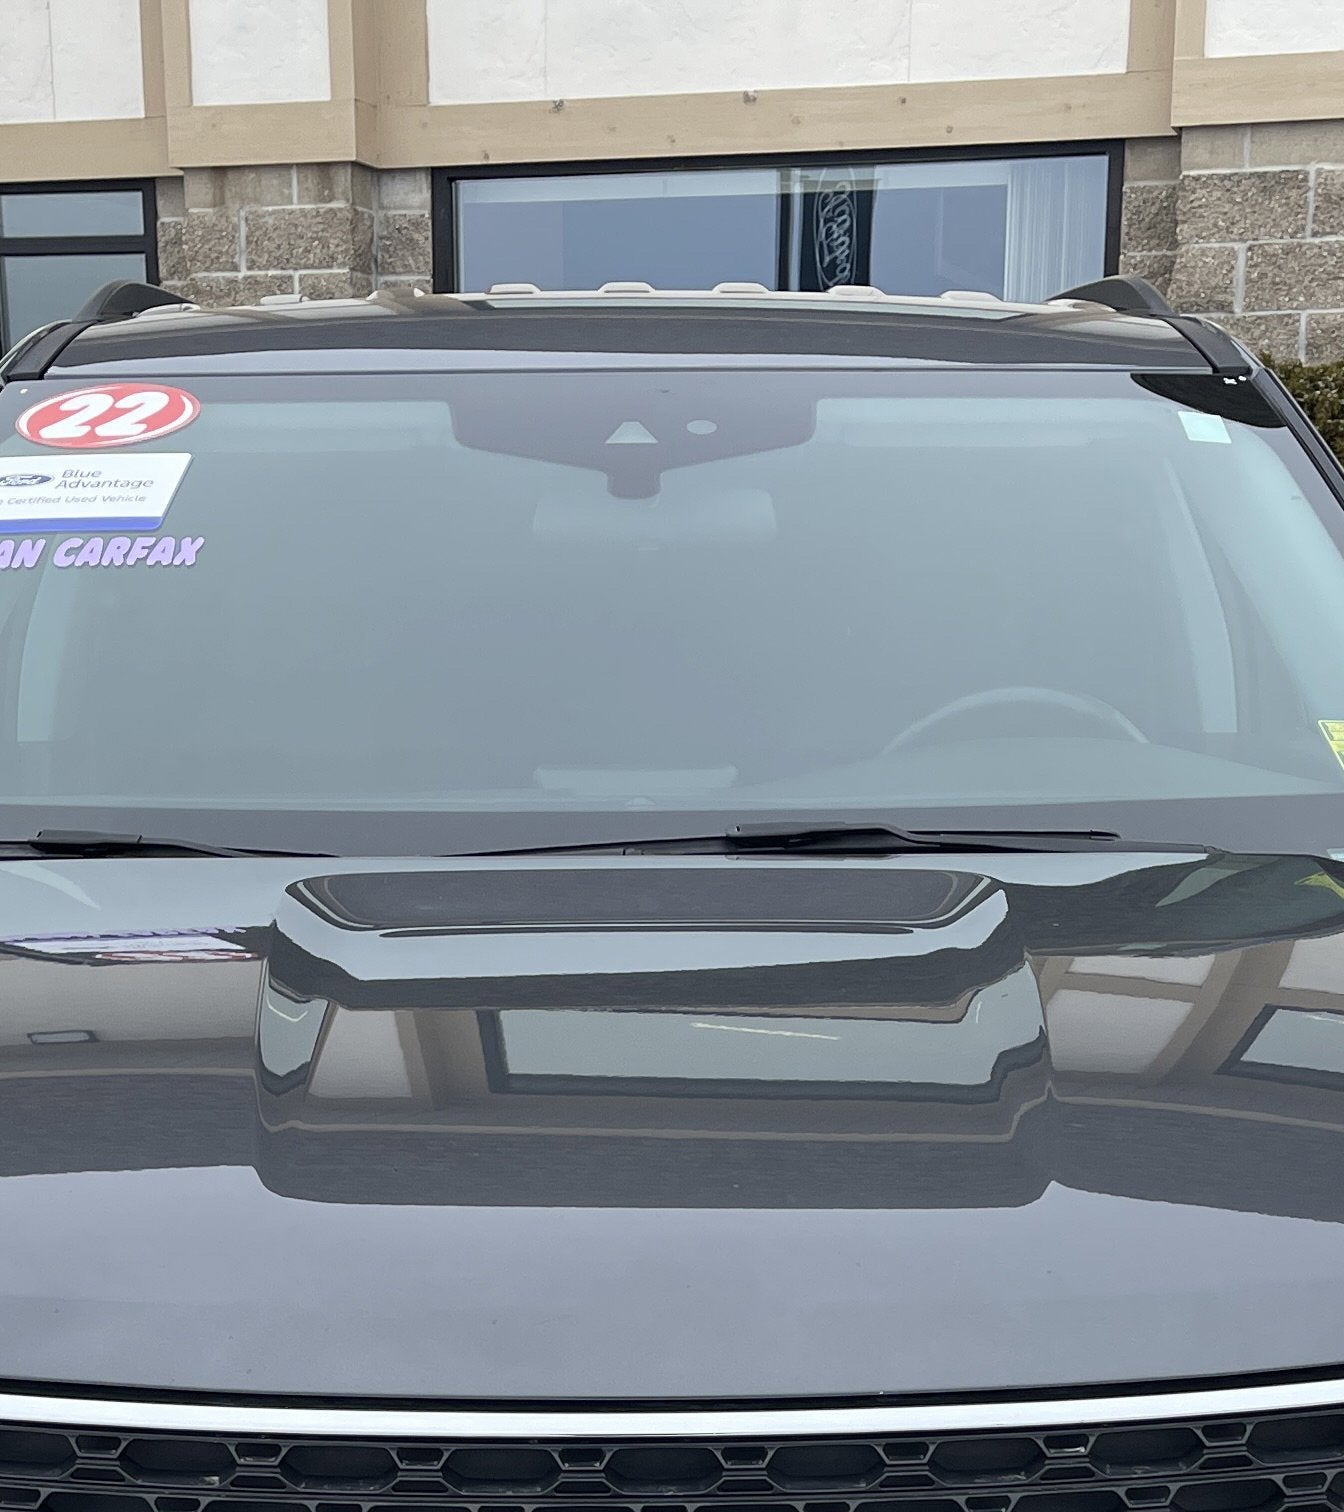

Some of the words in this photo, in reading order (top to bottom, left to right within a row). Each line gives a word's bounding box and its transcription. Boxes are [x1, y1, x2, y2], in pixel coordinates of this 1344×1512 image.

[39, 391, 170, 438] 22
[61, 469, 103, 478] Blue
[54, 479, 154, 490] Advantage
[7, 496, 61, 505] Certified
[64, 495, 97, 503] Used
[102, 494, 147, 503] Vehicle
[53, 536, 205, 568] CARFAX
